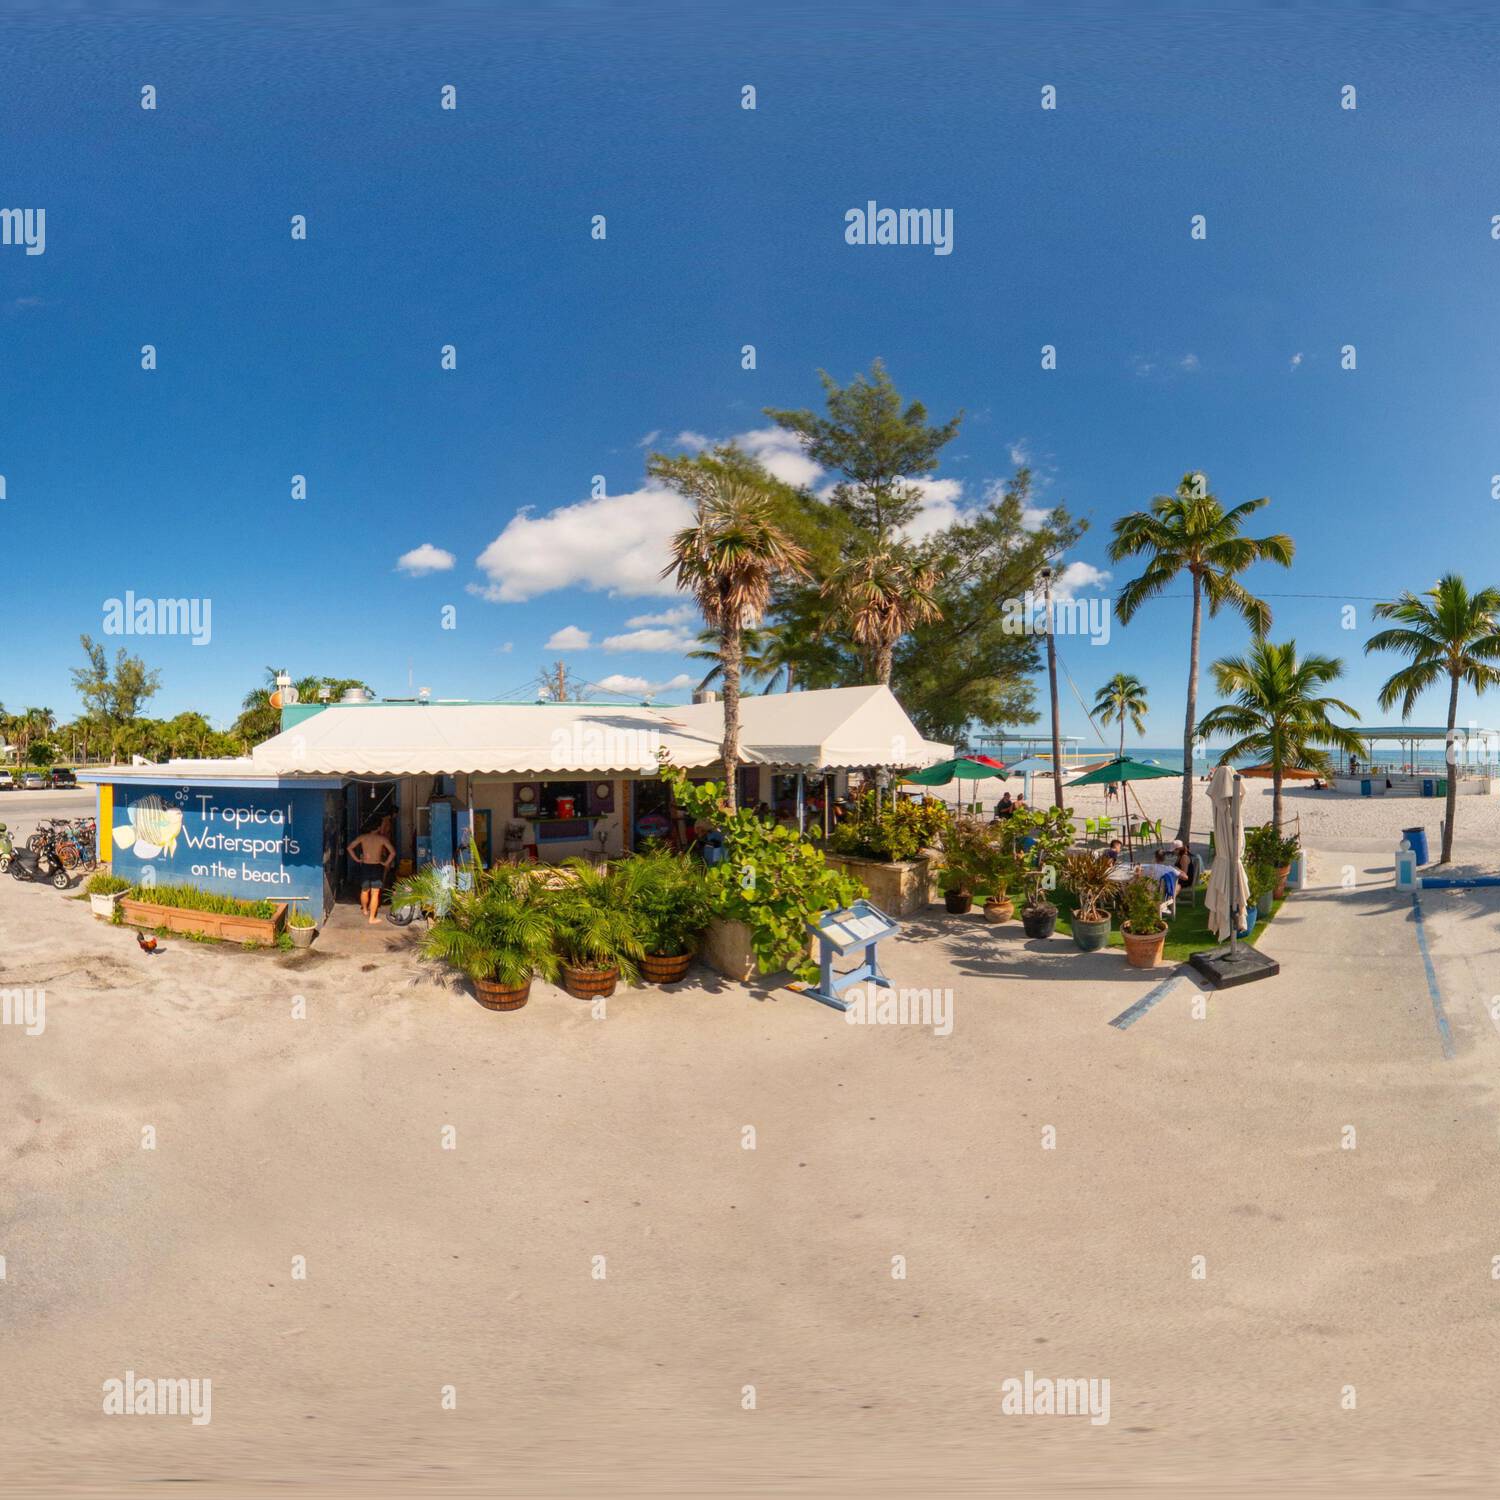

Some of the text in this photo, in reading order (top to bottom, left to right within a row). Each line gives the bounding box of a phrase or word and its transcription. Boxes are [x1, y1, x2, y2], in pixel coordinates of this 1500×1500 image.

[195, 794, 292, 831] Tropical
[182, 824, 300, 859] Watersports
[191, 860, 291, 884] on the beach
